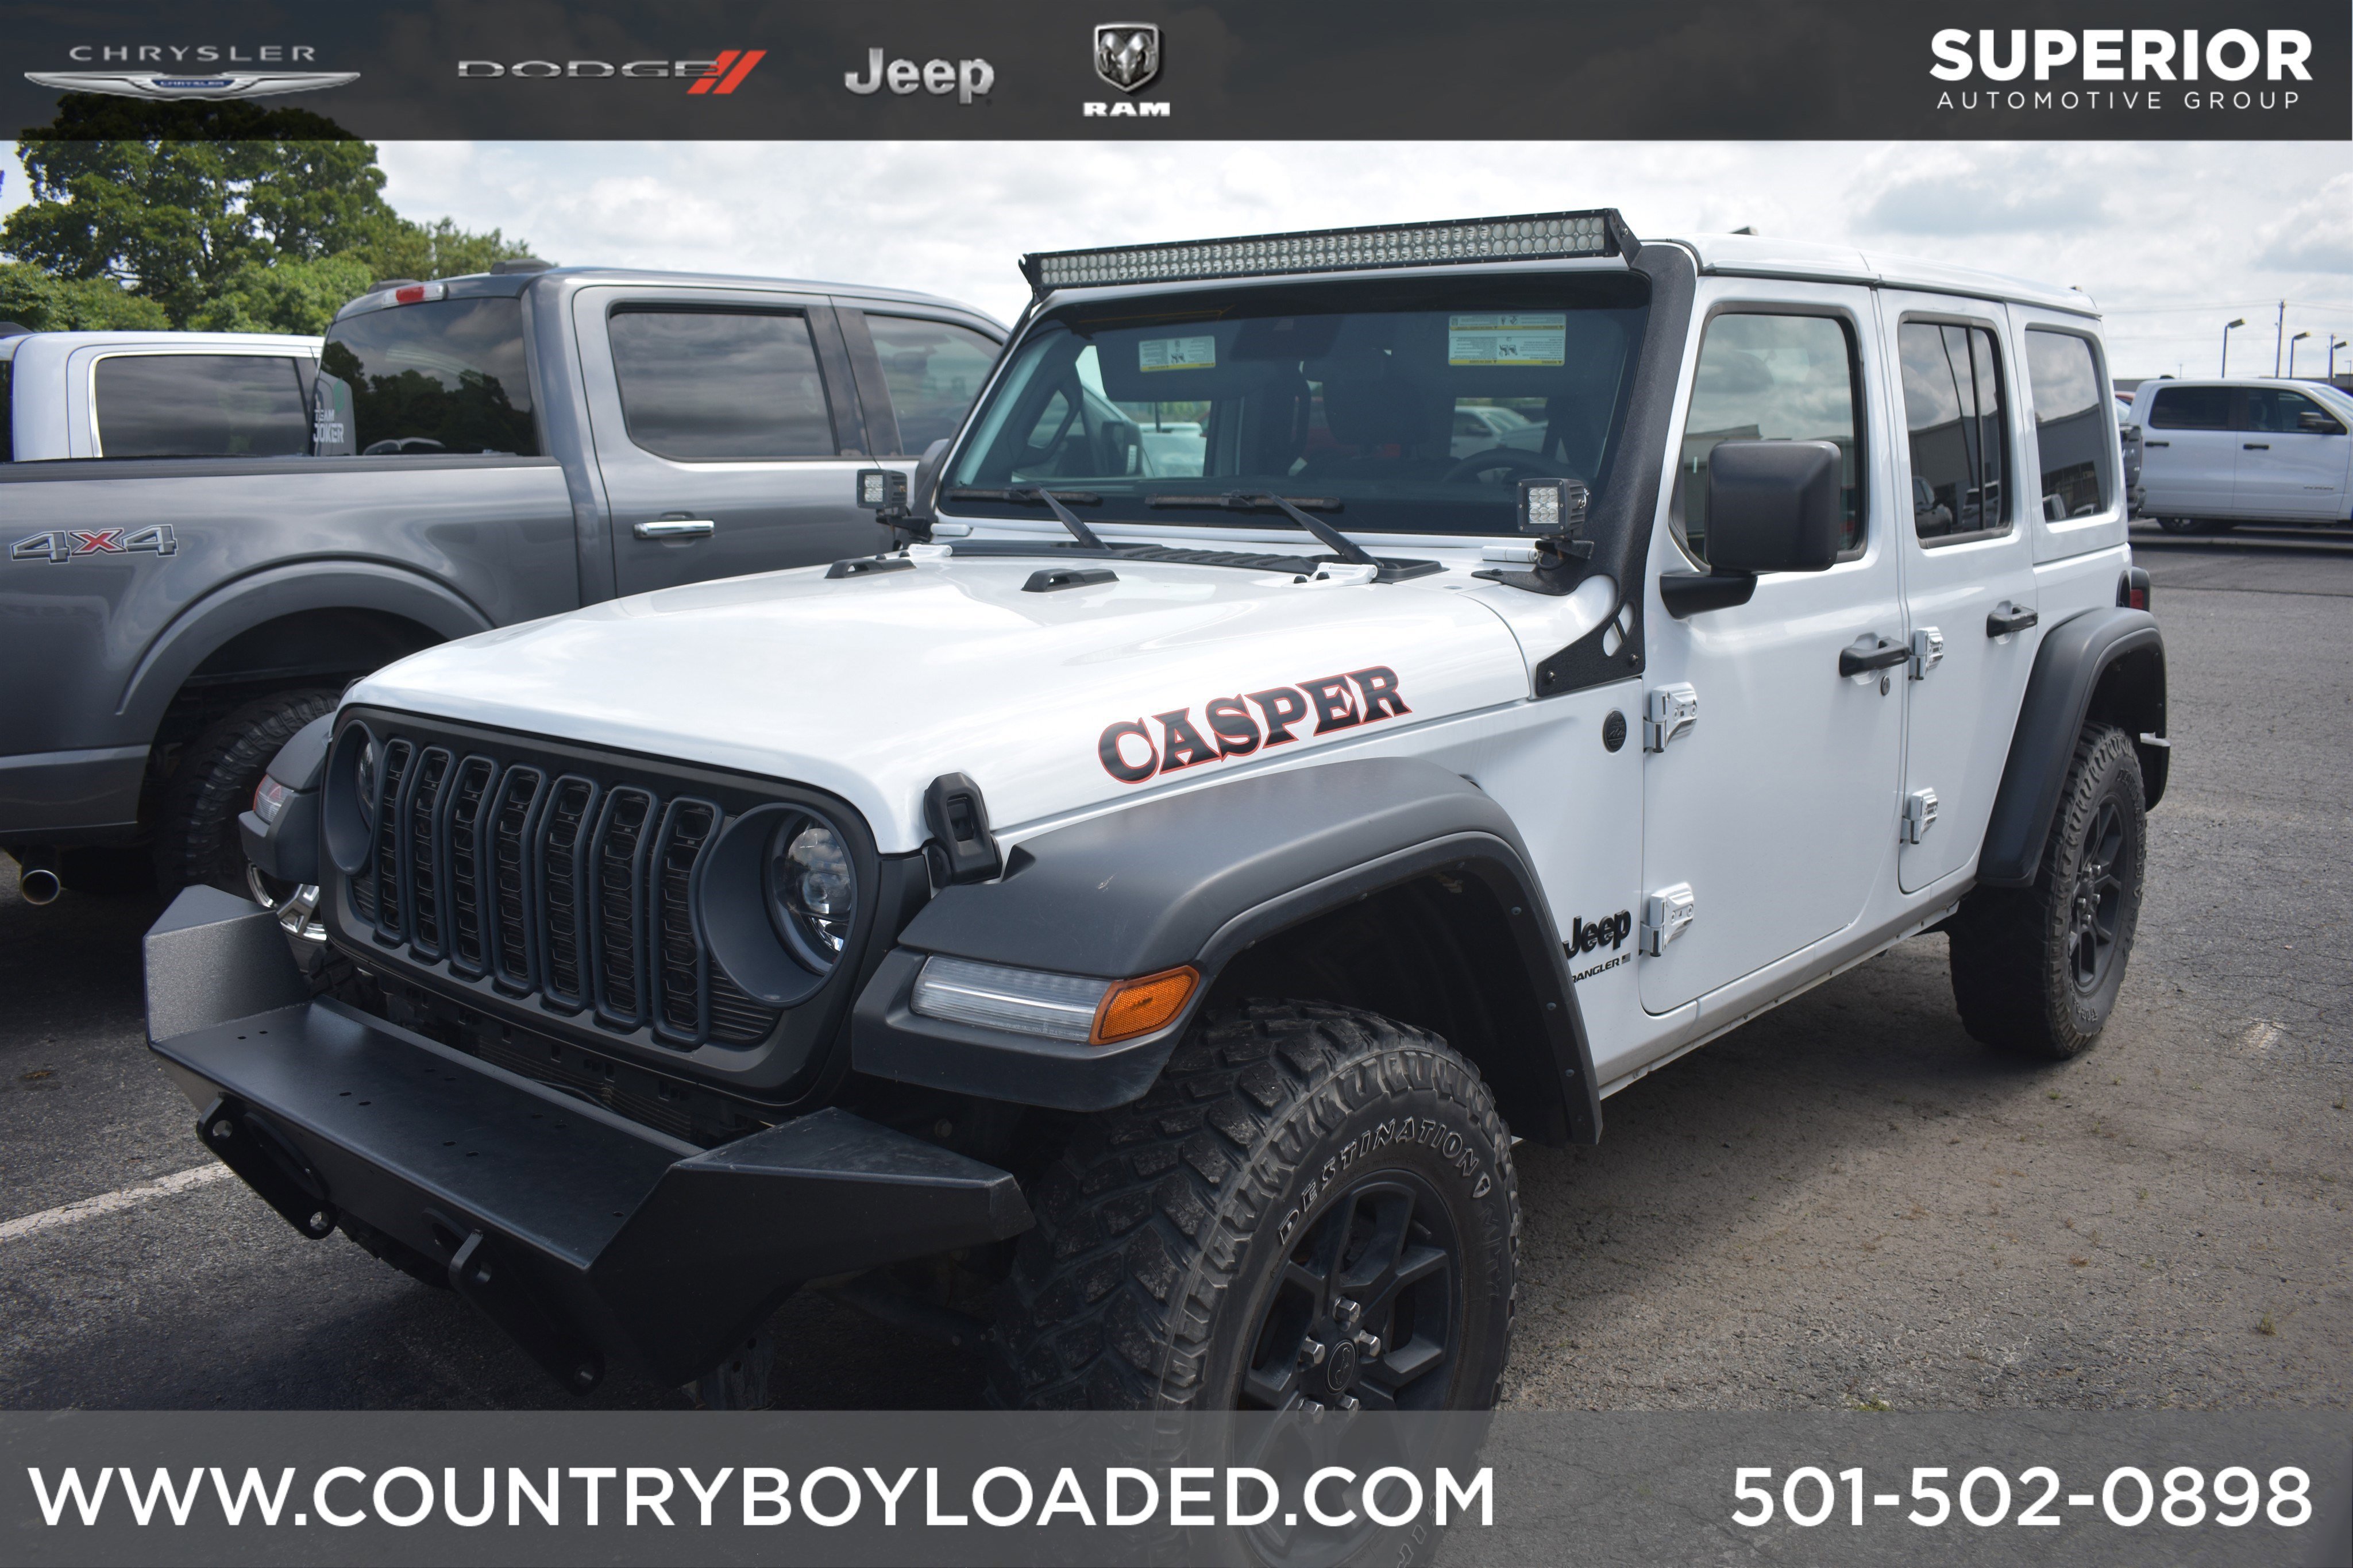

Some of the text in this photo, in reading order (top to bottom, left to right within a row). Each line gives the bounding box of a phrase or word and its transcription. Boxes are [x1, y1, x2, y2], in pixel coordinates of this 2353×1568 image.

[313, 423, 345, 443] JOKER
[314, 408, 335, 422] TEAM
[1098, 666, 1413, 785] CASPER
[1562, 909, 1631, 960] Jeep
[1572, 957, 1620, 983] RANGLER
[1277, 1116, 1481, 1246] DESTINATION
